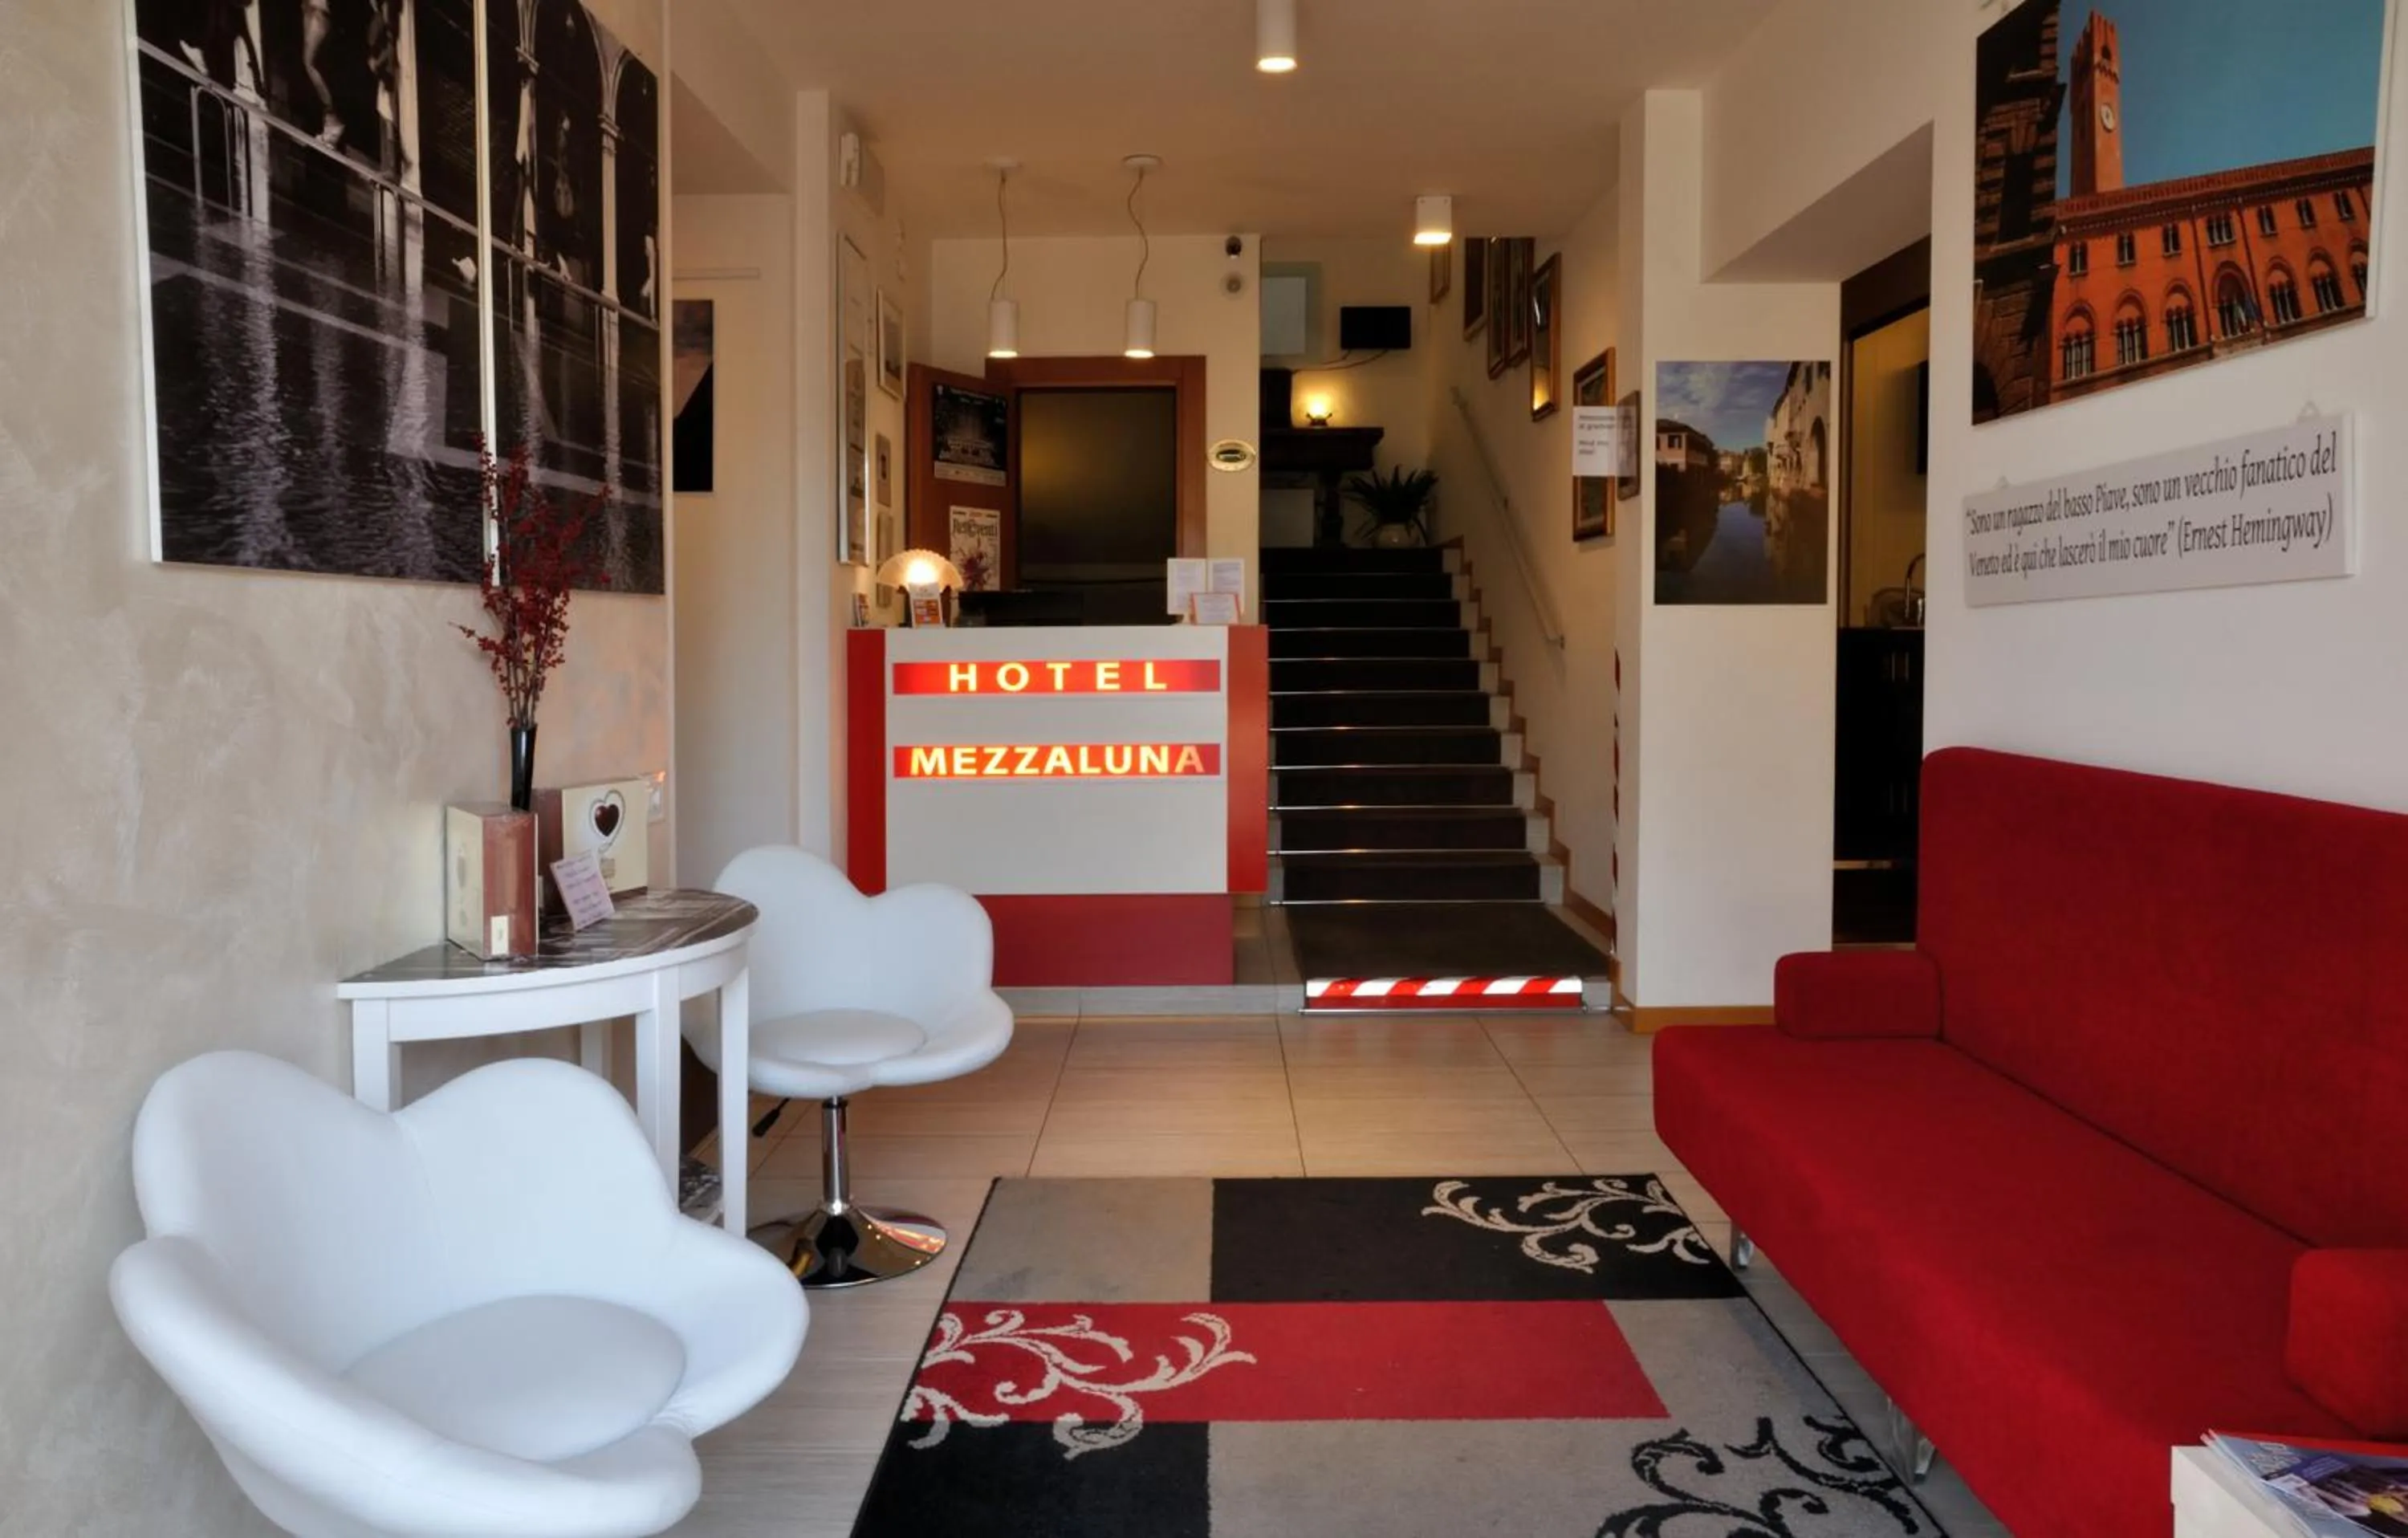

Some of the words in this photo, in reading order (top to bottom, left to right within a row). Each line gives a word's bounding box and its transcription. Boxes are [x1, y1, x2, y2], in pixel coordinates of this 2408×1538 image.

[1993, 511, 2007, 531] un
[2007, 504, 2044, 536] ragazzo
[2046, 488, 2061, 521] del
[2064, 487, 2093, 519] basso
[2096, 482, 2129, 512] Piave,
[2132, 480, 2160, 507] sono
[2162, 476, 2181, 502] un
[2185, 454, 2237, 498] vecchio
[2239, 446, 2306, 499] fanatico
[2310, 430, 2337, 476] del
[1969, 551, 1999, 576] Veneto
[2002, 543, 2012, 573] ed
[2021, 542, 2037, 580] qui
[2039, 536, 2056, 569] che
[2059, 535, 2096, 566] lascerò
[2098, 528, 2106, 562] il
[2109, 530, 2130, 560] mio
[2178, 515, 2228, 559] (Ernest
[2231, 490, 2333, 553] Hemingway)
[949, 661, 1168, 692] HOTEL
[909, 746, 1204, 776] MEZZALUNA
